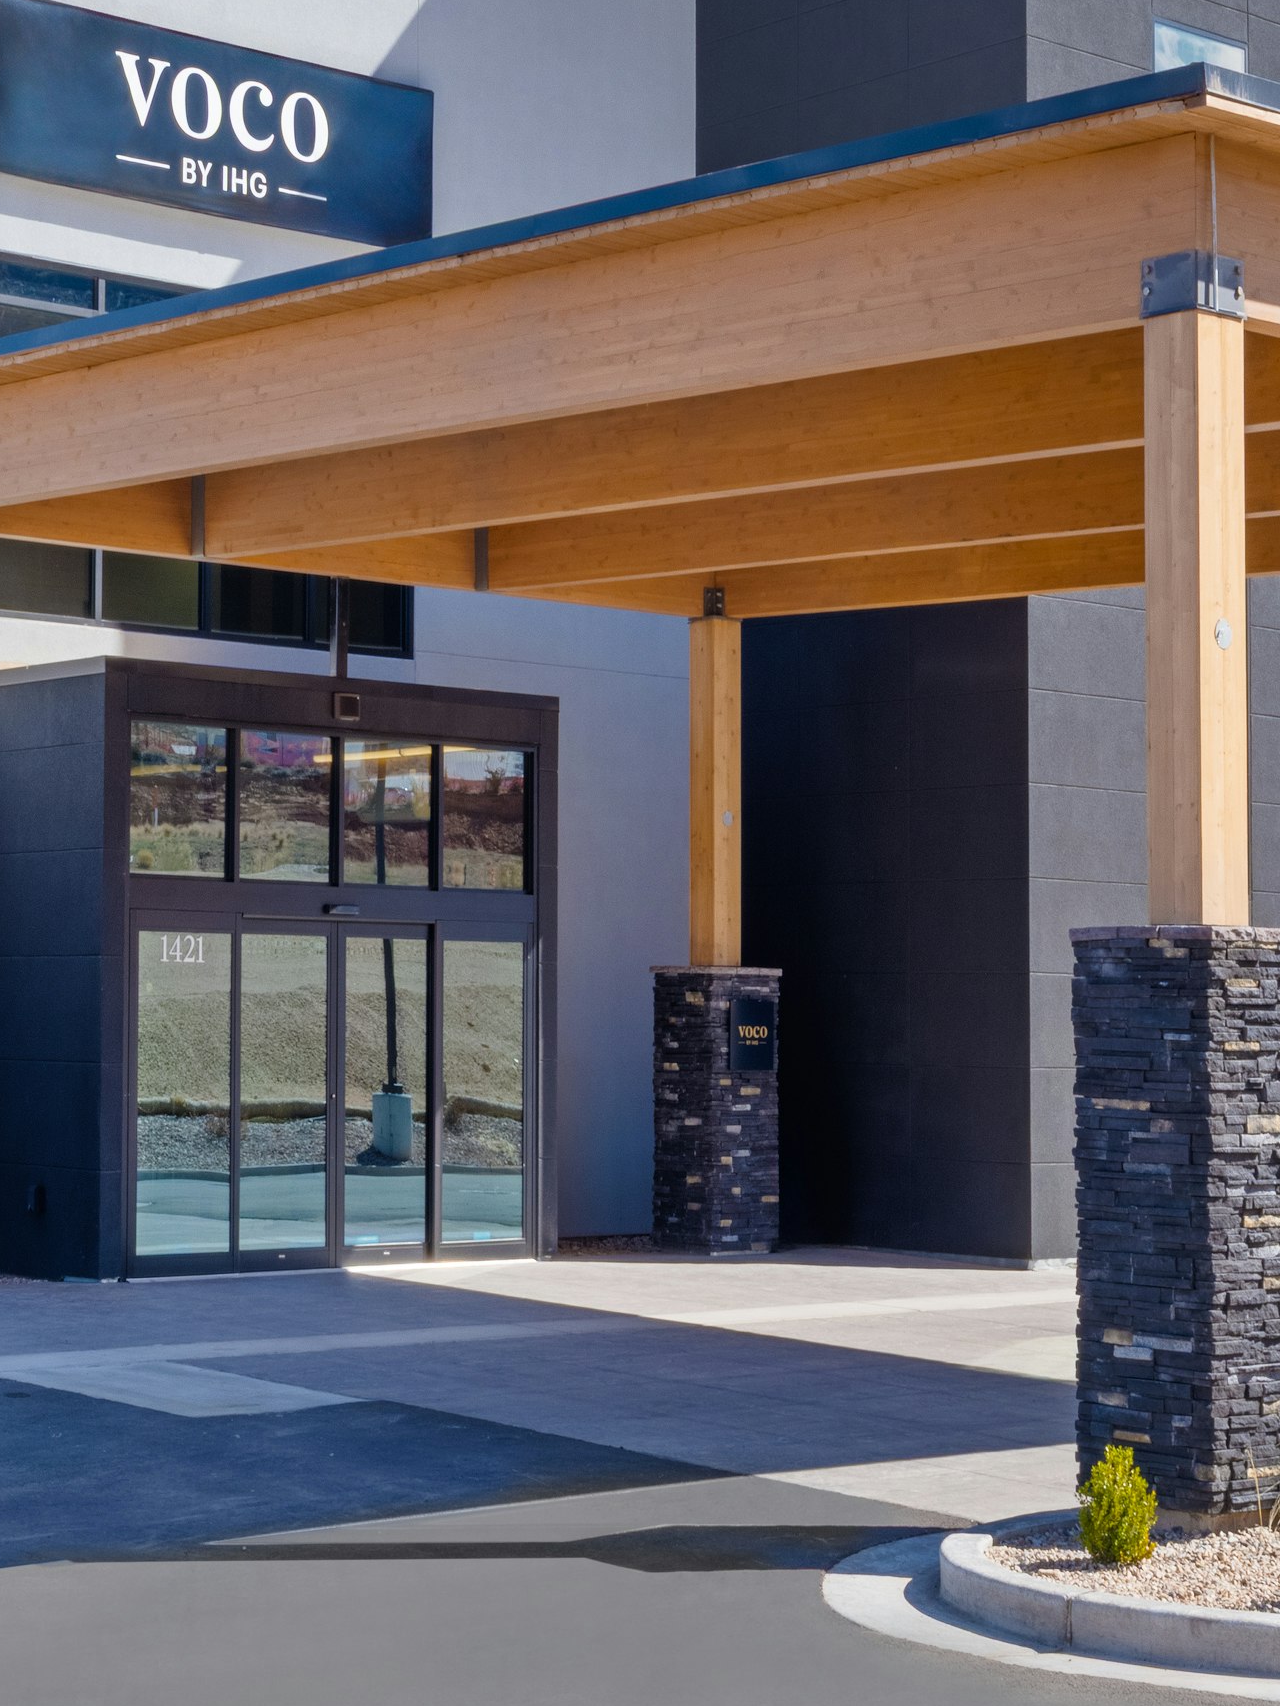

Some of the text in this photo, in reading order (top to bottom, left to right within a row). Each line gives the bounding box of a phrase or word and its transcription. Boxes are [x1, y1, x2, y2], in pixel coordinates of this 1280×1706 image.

[115, 50, 329, 163] VOCO
[182, 156, 268, 199] BY IHG
[160, 934, 206, 963] 1421
[738, 1025, 768, 1038] VOCO
